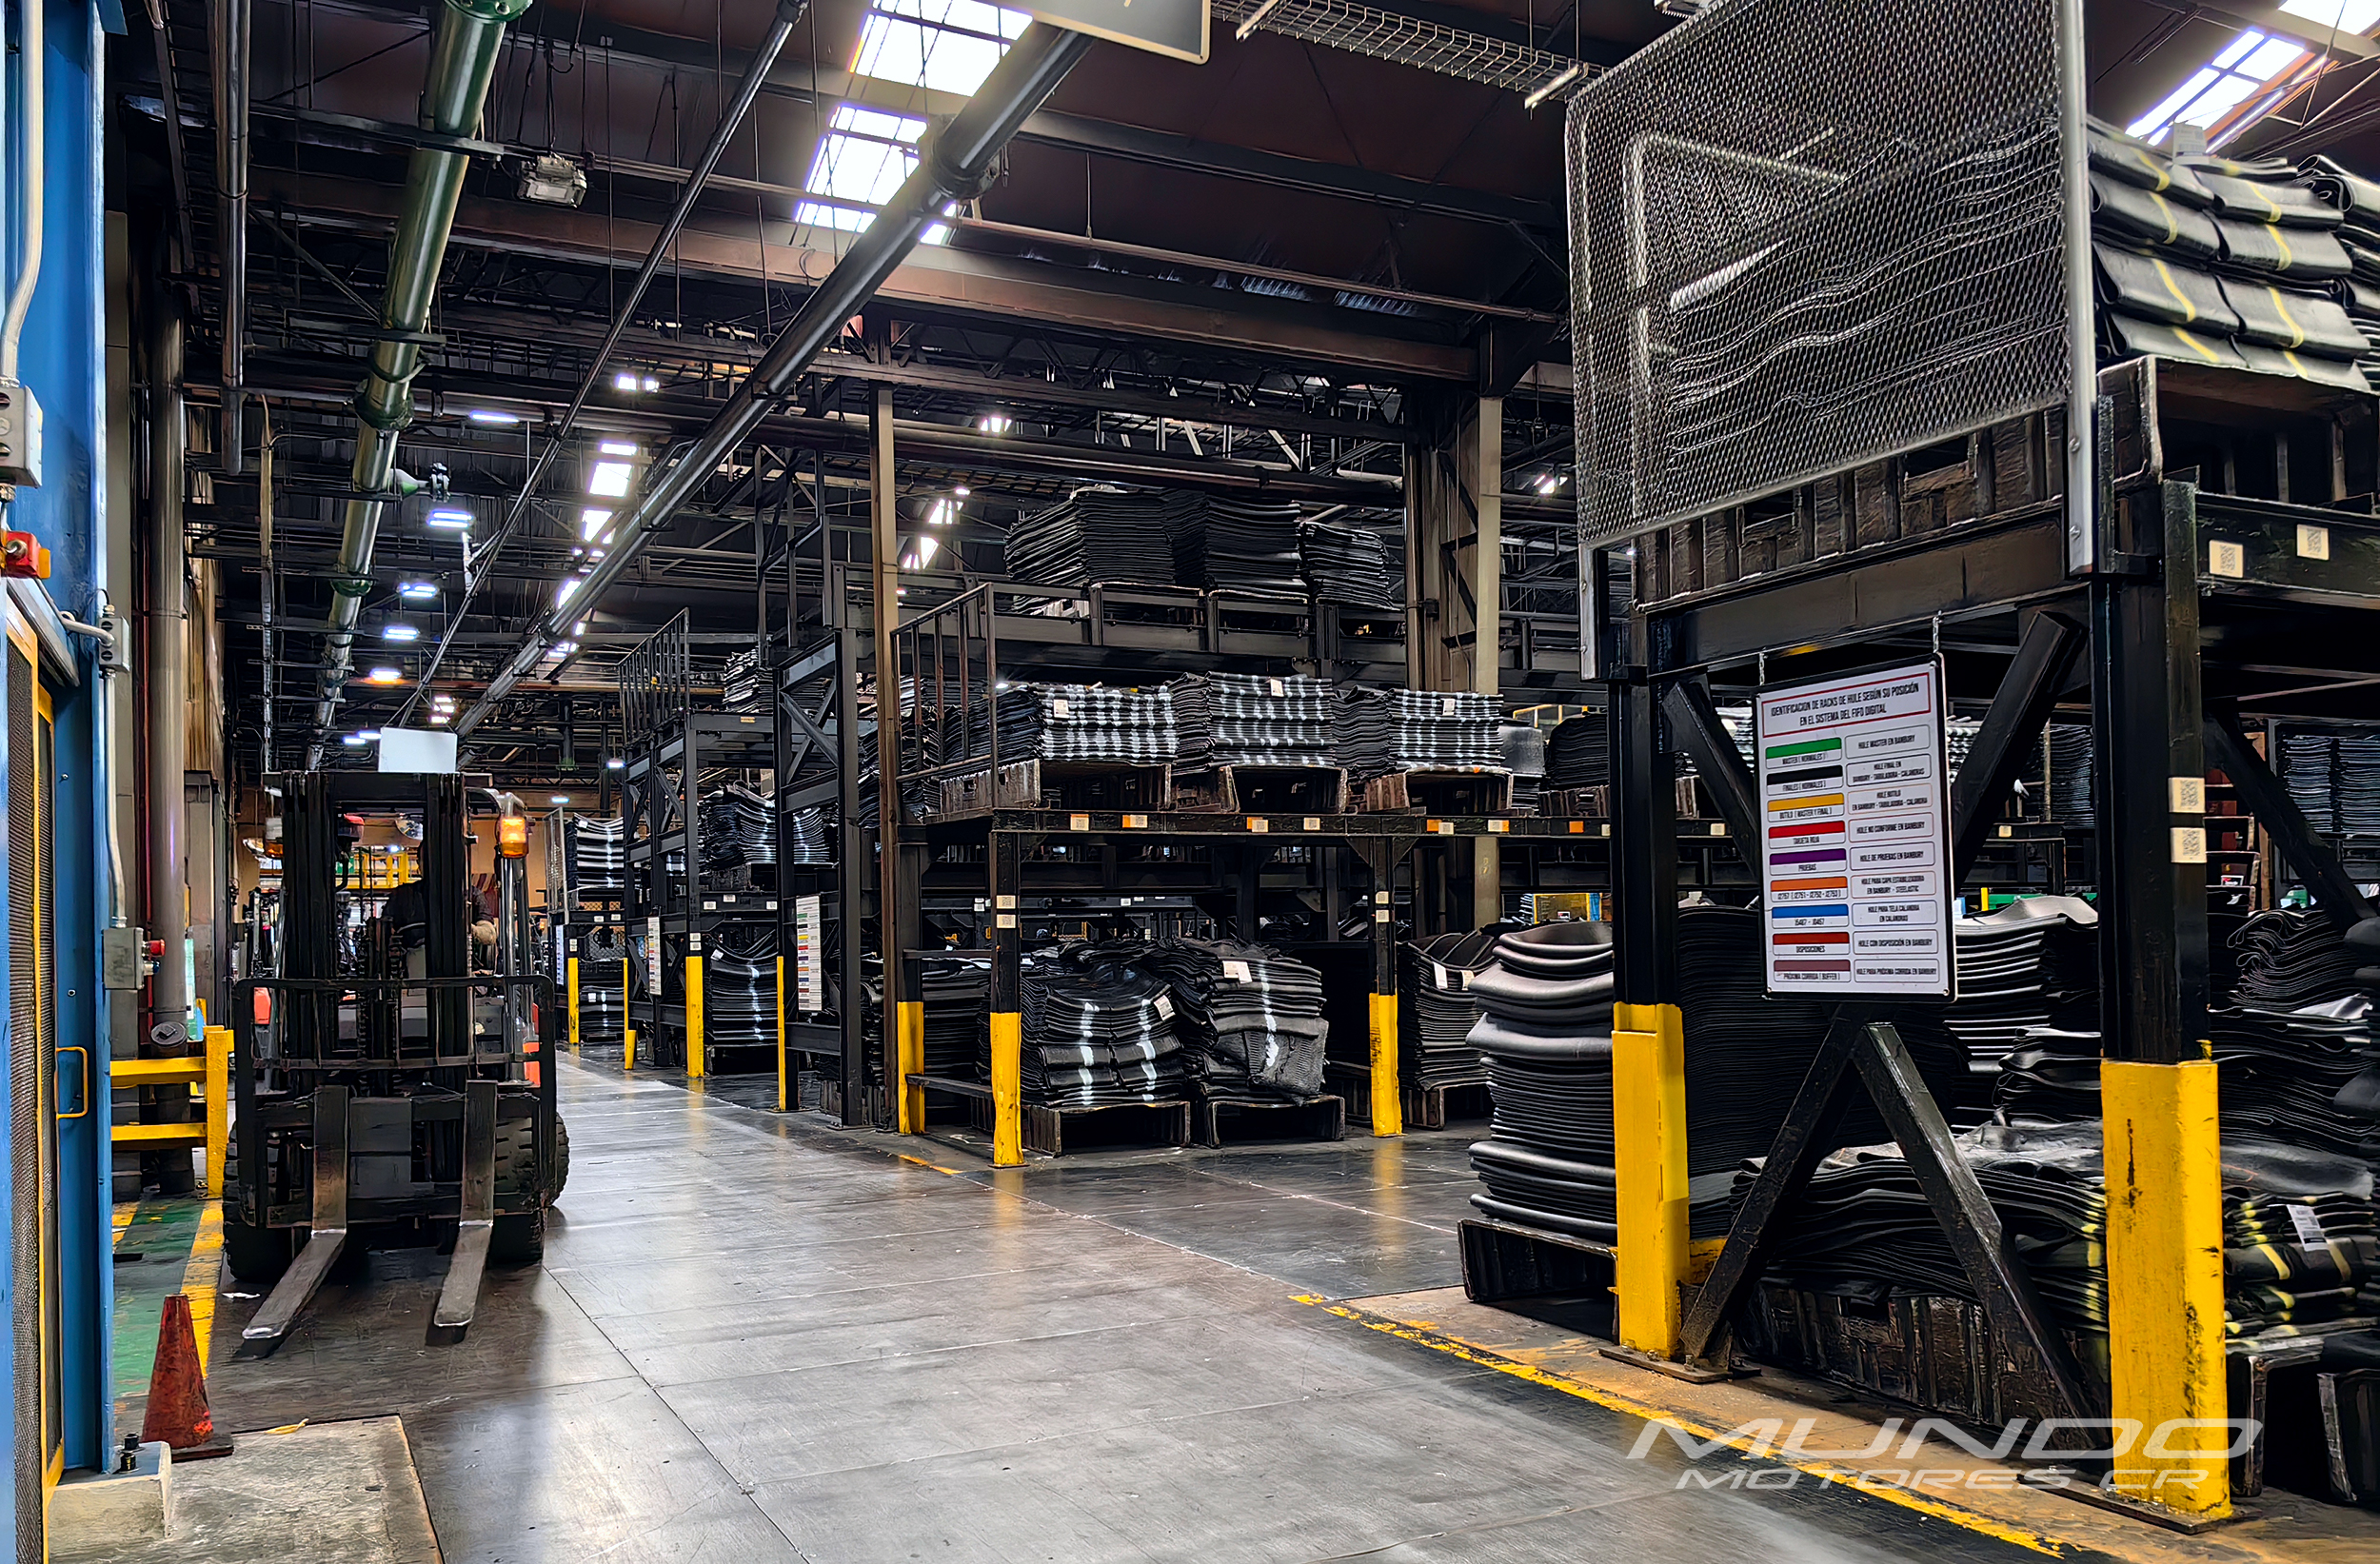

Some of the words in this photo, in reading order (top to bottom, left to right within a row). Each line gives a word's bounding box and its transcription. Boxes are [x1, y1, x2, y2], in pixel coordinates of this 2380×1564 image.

[1771, 702, 1811, 716] IDENTIFICACION
[1812, 700, 1819, 709] DE
[1820, 697, 1838, 708] RACKS
[1839, 695, 1846, 705] DE
[1847, 693, 1861, 703] HULE
[1863, 688, 1881, 701] SEGÚN
[1883, 687, 1890, 698] SU
[1891, 682, 1919, 696] POSICIÓN
[1800, 716, 1807, 726] EN
[1808, 715, 1815, 724] EL
[1815, 711, 1839, 723] SISTEMA
[1841, 709, 1850, 719] DEL
[1852, 706, 1864, 717] FIFO
[1865, 703, 1887, 716] DIGITAL
